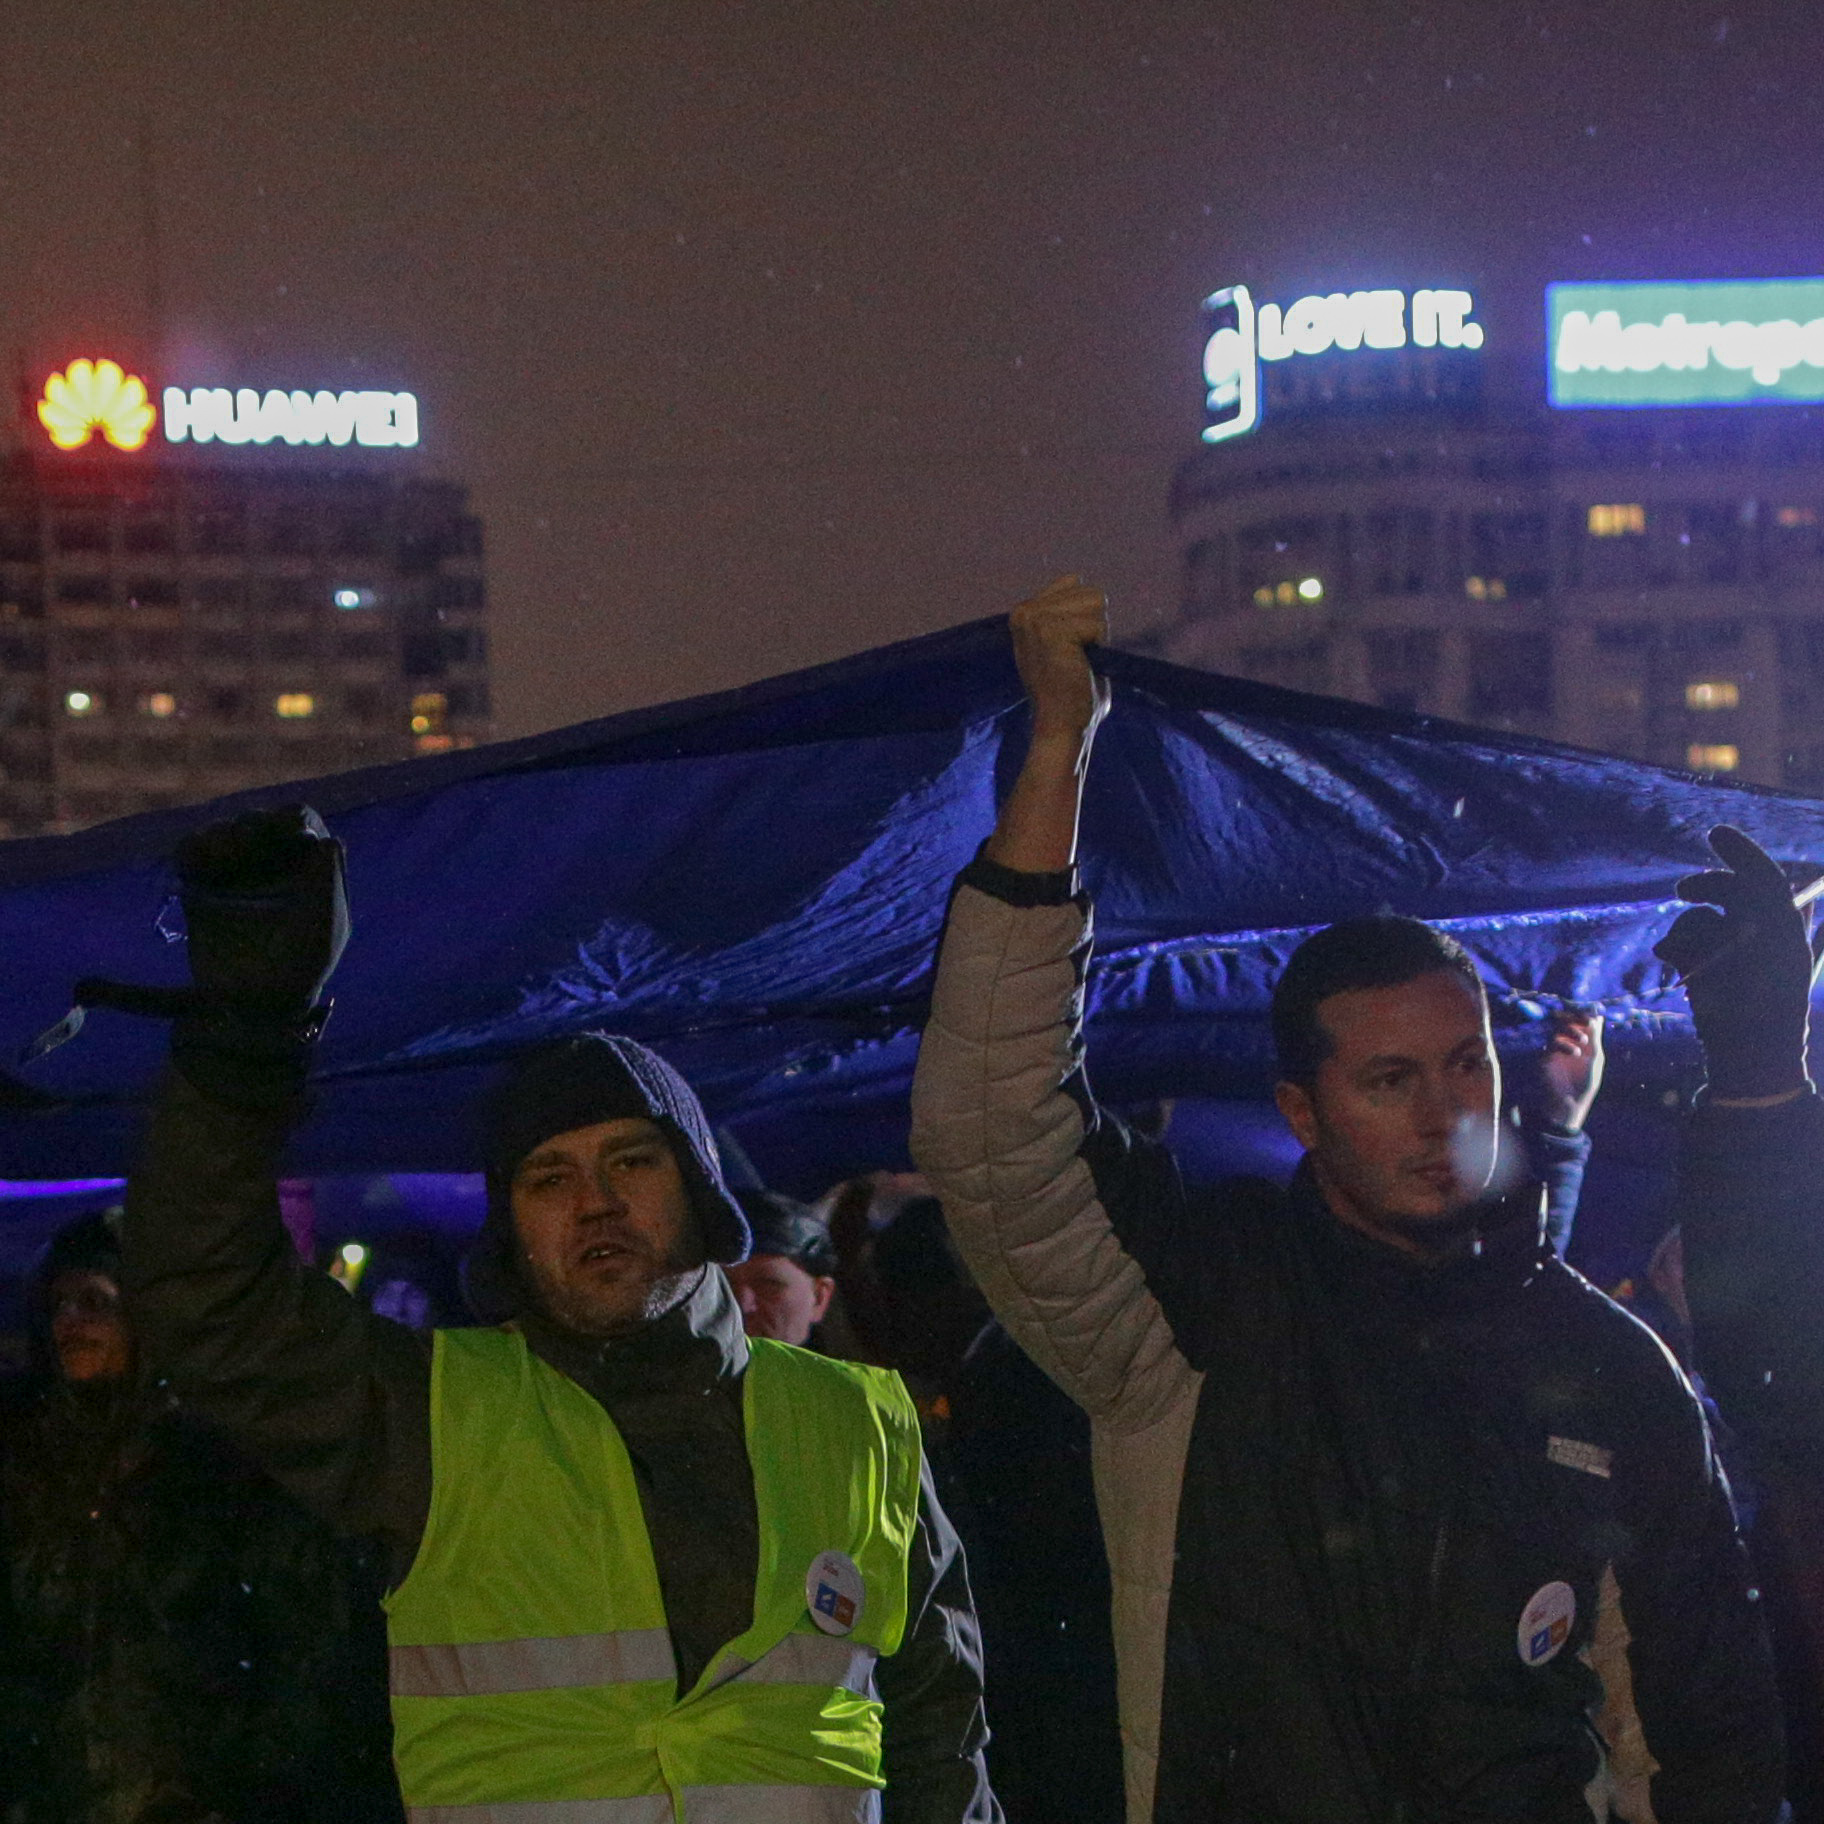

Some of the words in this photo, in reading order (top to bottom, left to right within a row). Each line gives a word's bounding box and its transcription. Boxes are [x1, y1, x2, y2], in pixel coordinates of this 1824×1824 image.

[1258, 290, 1407, 361] LOVE
[1412, 289, 1484, 349] IT.
[162, 386, 419, 447] HUAWEI
